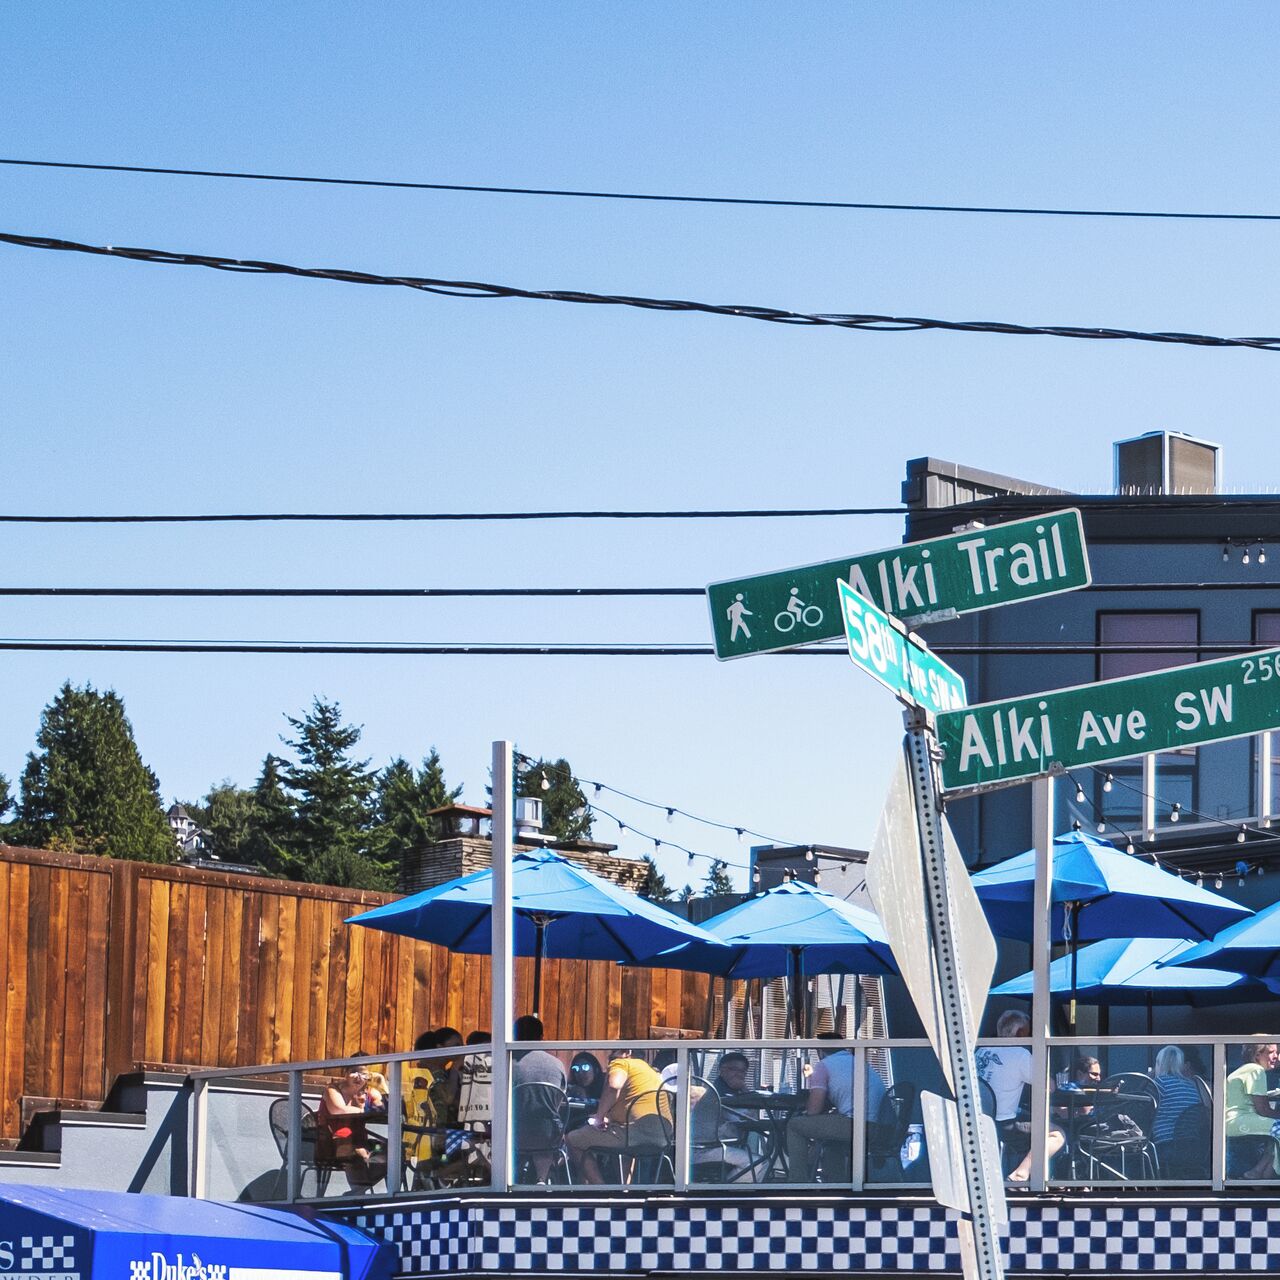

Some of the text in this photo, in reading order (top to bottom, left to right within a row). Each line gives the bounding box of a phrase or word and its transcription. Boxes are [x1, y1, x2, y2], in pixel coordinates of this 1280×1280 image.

[848, 522, 1067, 613] Alki Trail
[845, 594, 898, 674] 58th
[958, 684, 1233, 772] Alki Ave SW
